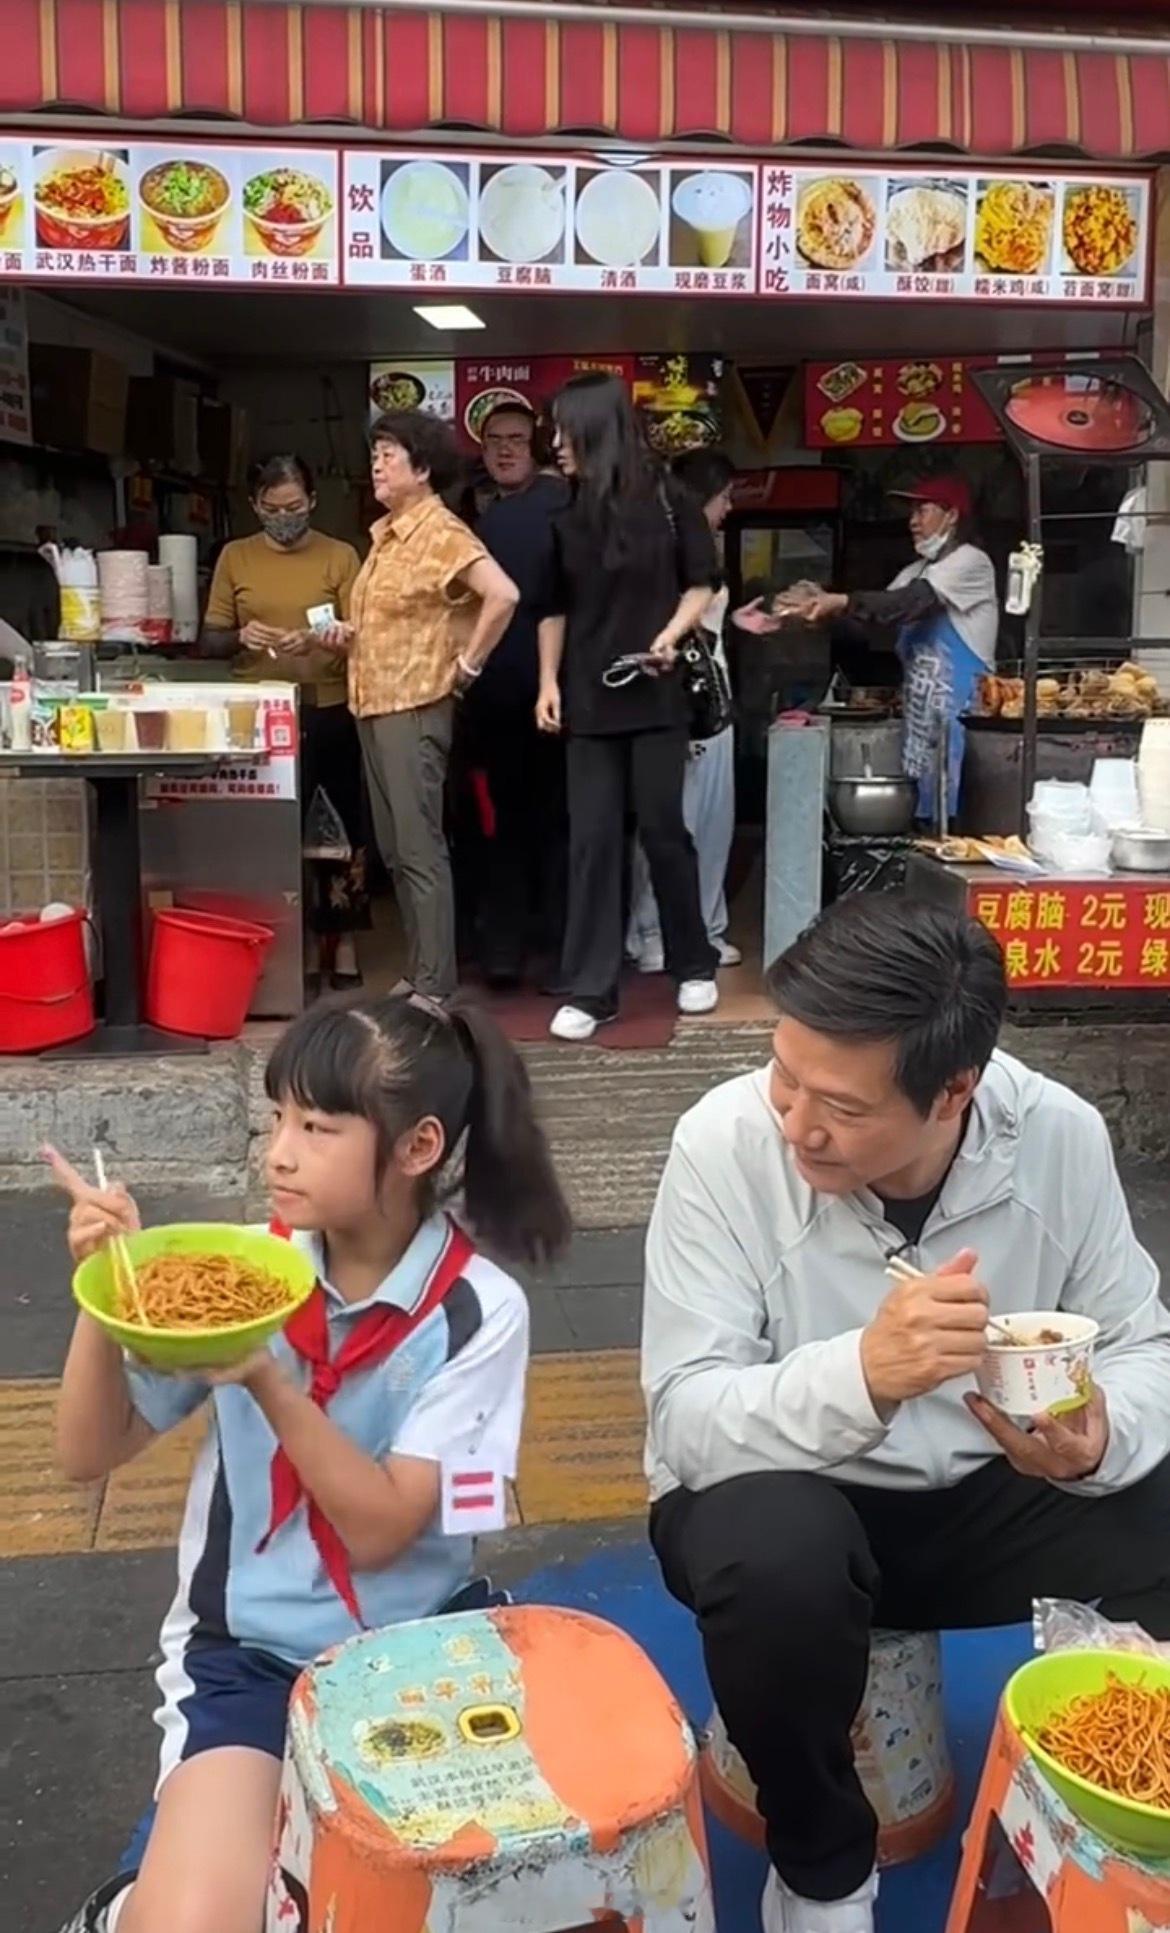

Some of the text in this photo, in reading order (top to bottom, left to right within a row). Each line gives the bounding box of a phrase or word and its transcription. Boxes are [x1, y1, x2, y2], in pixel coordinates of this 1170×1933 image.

[348, 183, 375, 259] 饮品
[765, 170, 793, 293] 炸物小吃
[0, 251, 23, 271] 面
[35, 252, 137, 273] 武汉热干面
[150, 257, 230, 277] 炸酱粉面
[251, 261, 329, 281] 肉丝粉面
[410, 263, 446, 281] 蛋酒
[496, 266, 552, 284] 豆腐脑
[601, 269, 637, 287] 清酒
[674, 272, 746, 289] 现磨豆浆
[478, 365, 531, 383] 牛肉面
[976, 890, 1170, 930] 豆腐脑 2元 现
[1005, 937, 1169, 977] 泉水 2元 绿
